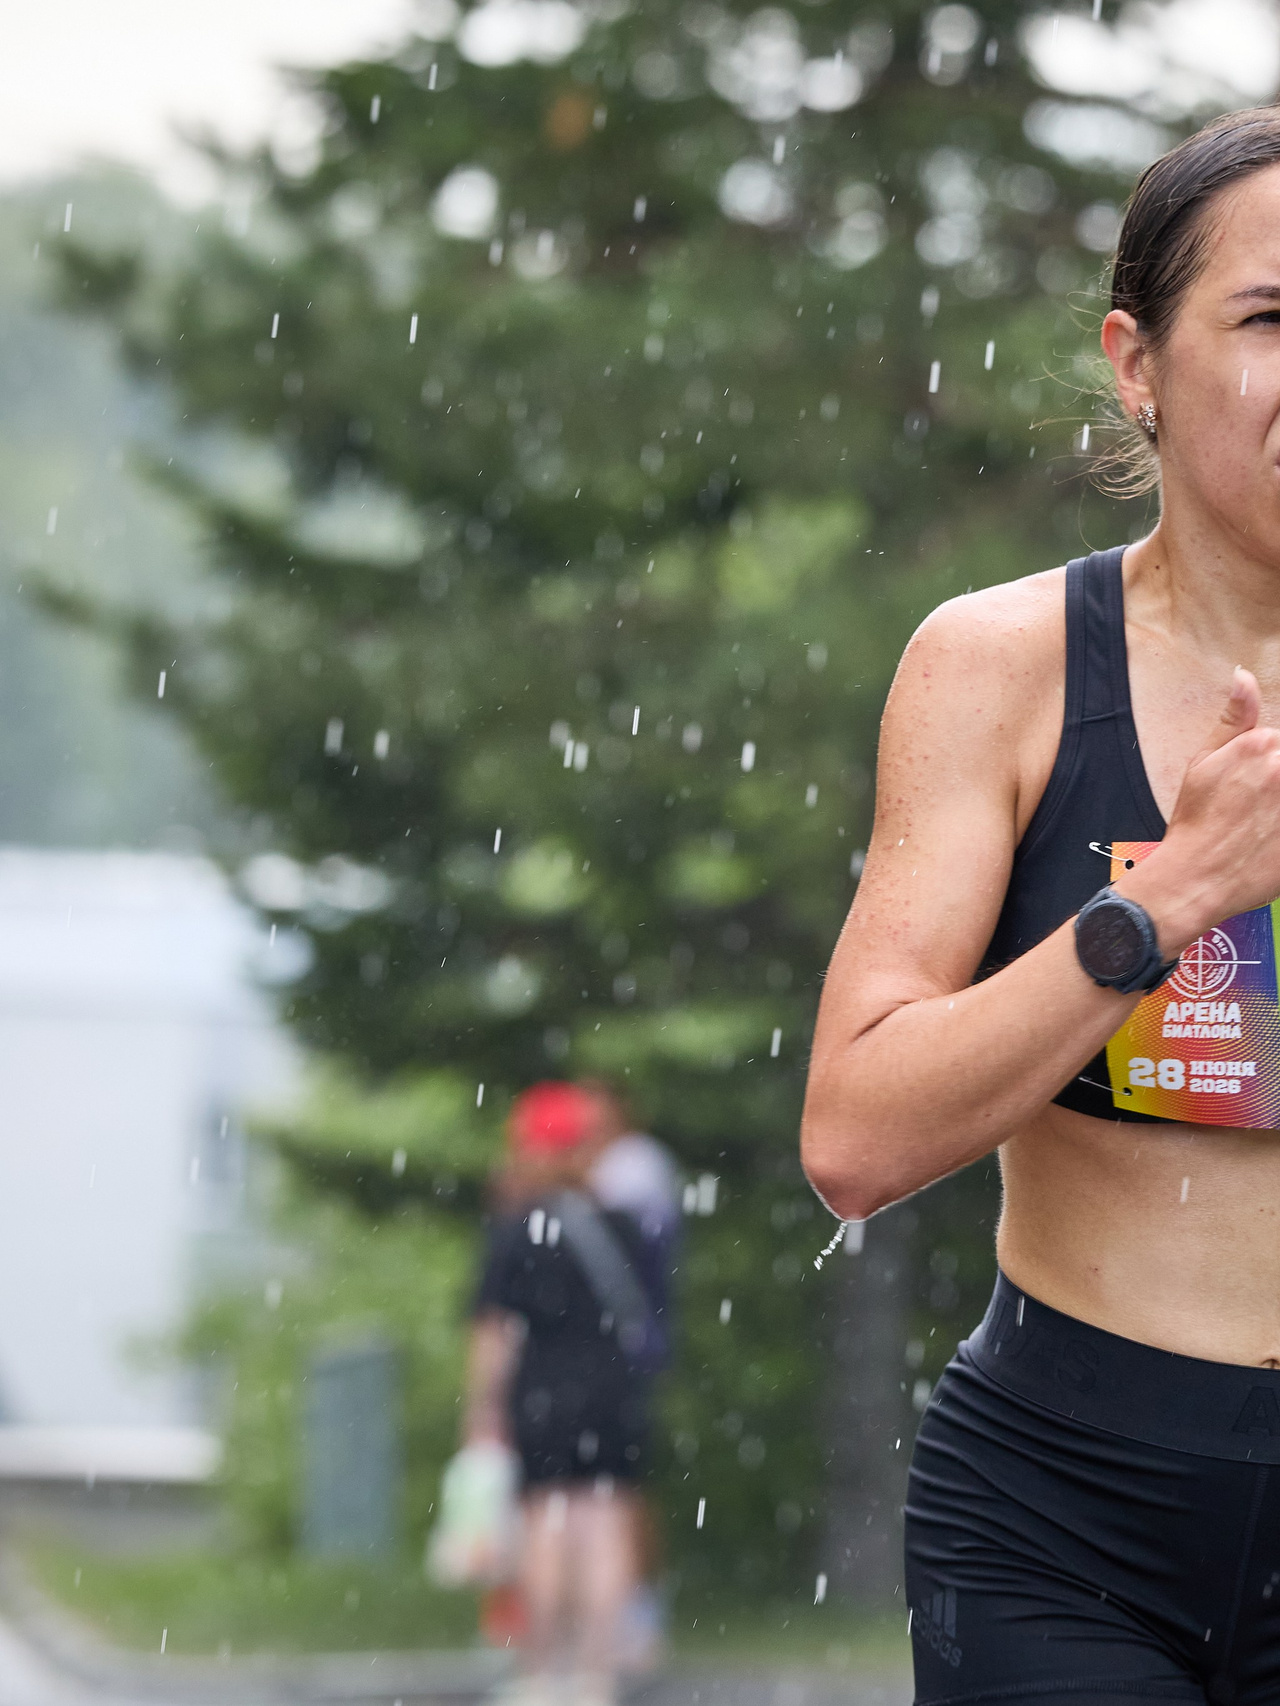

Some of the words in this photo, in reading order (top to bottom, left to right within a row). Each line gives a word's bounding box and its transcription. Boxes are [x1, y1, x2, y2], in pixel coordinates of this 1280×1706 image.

[1163, 1001, 1242, 1023] АРЕНА
[1162, 1024, 1242, 1038] БИАТЛОНА
[1128, 1057, 1185, 1090] 28
[1189, 1078, 1242, 1093] 2026
